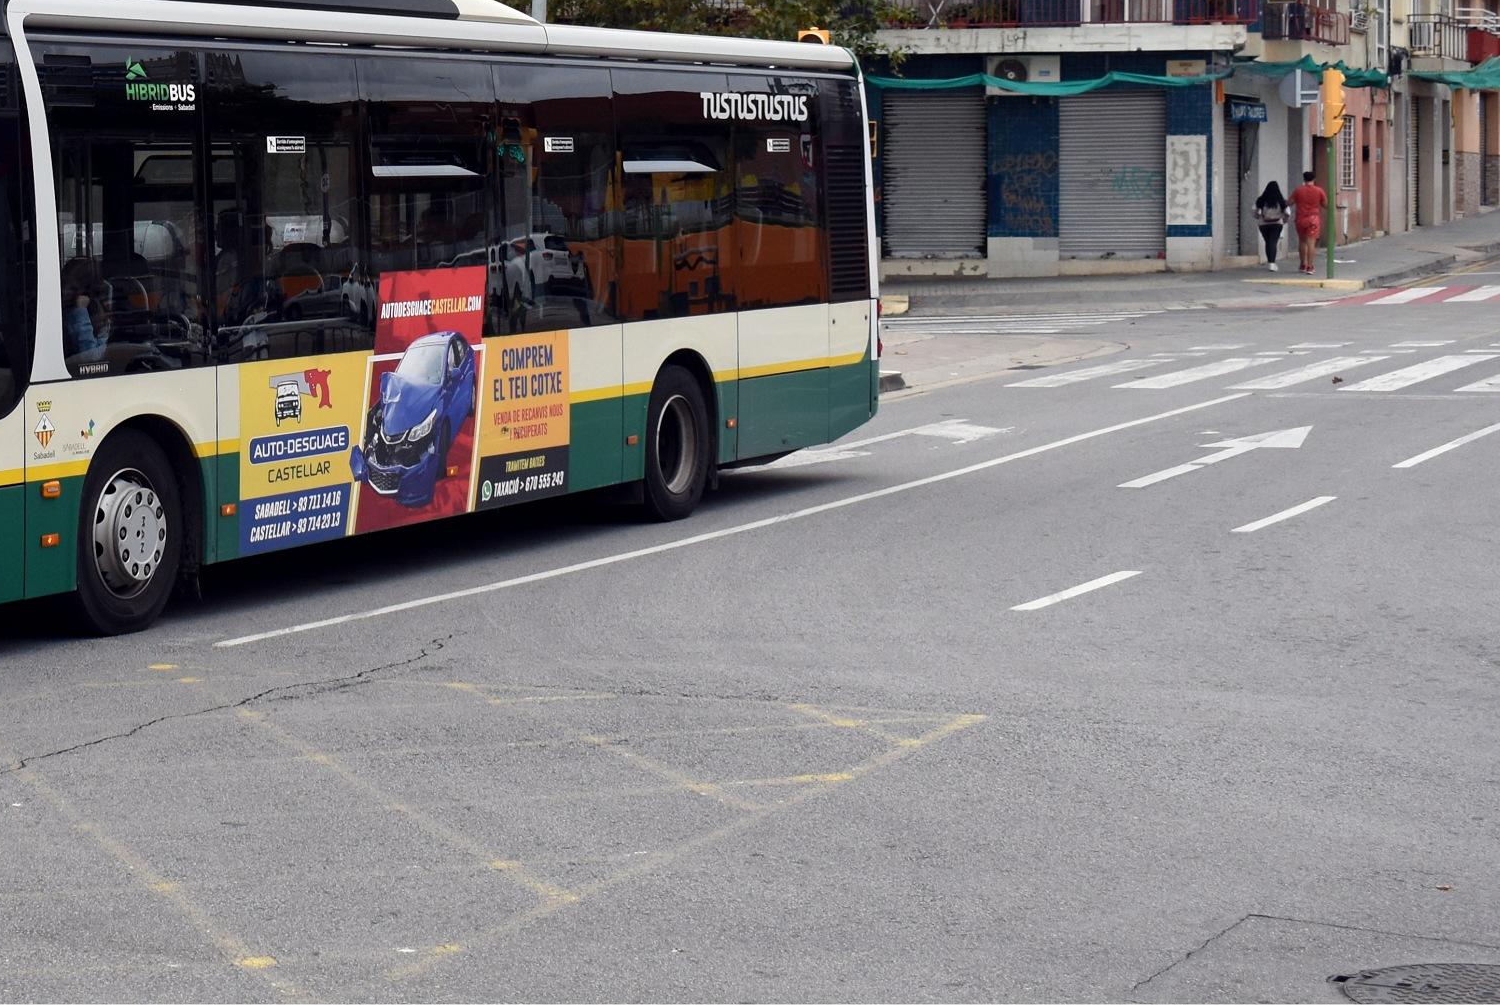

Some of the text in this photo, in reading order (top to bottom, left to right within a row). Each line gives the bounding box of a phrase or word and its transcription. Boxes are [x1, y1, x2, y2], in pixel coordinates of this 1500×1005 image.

[125, 83, 196, 102] HIBRIDBUS
[380, 295, 482, 320] AUTODESGUACECASTELLAR.COM
[79, 363, 109, 375] HYBRID
[502, 344, 554, 372] COMPREM
[493, 371, 562, 402] EL TEU COTXE
[493, 403, 564, 426] VENDA DE RECANVIS NOUS
[33, 450, 56, 460] Sabadell
[253, 432, 345, 459] AUTO-DESGUACE
[267, 460, 331, 484] CASTELLAR
[493, 477, 520, 498] TAXACIÓ
[525, 475, 539, 492] 670
[538, 473, 552, 489] 555
[551, 471, 565, 487] 243
[254, 499, 291, 520] SABADELL
[297, 496, 308, 512] 93
[308, 494, 321, 510] 711
[321, 492, 332, 508] 14
[331, 490, 342, 506] 16
[250, 521, 291, 543] CASTELLAR
[297, 517, 308, 534] 93
[307, 514, 321, 532] 714
[320, 513, 332, 529] 23
[331, 511, 342, 527] 13
